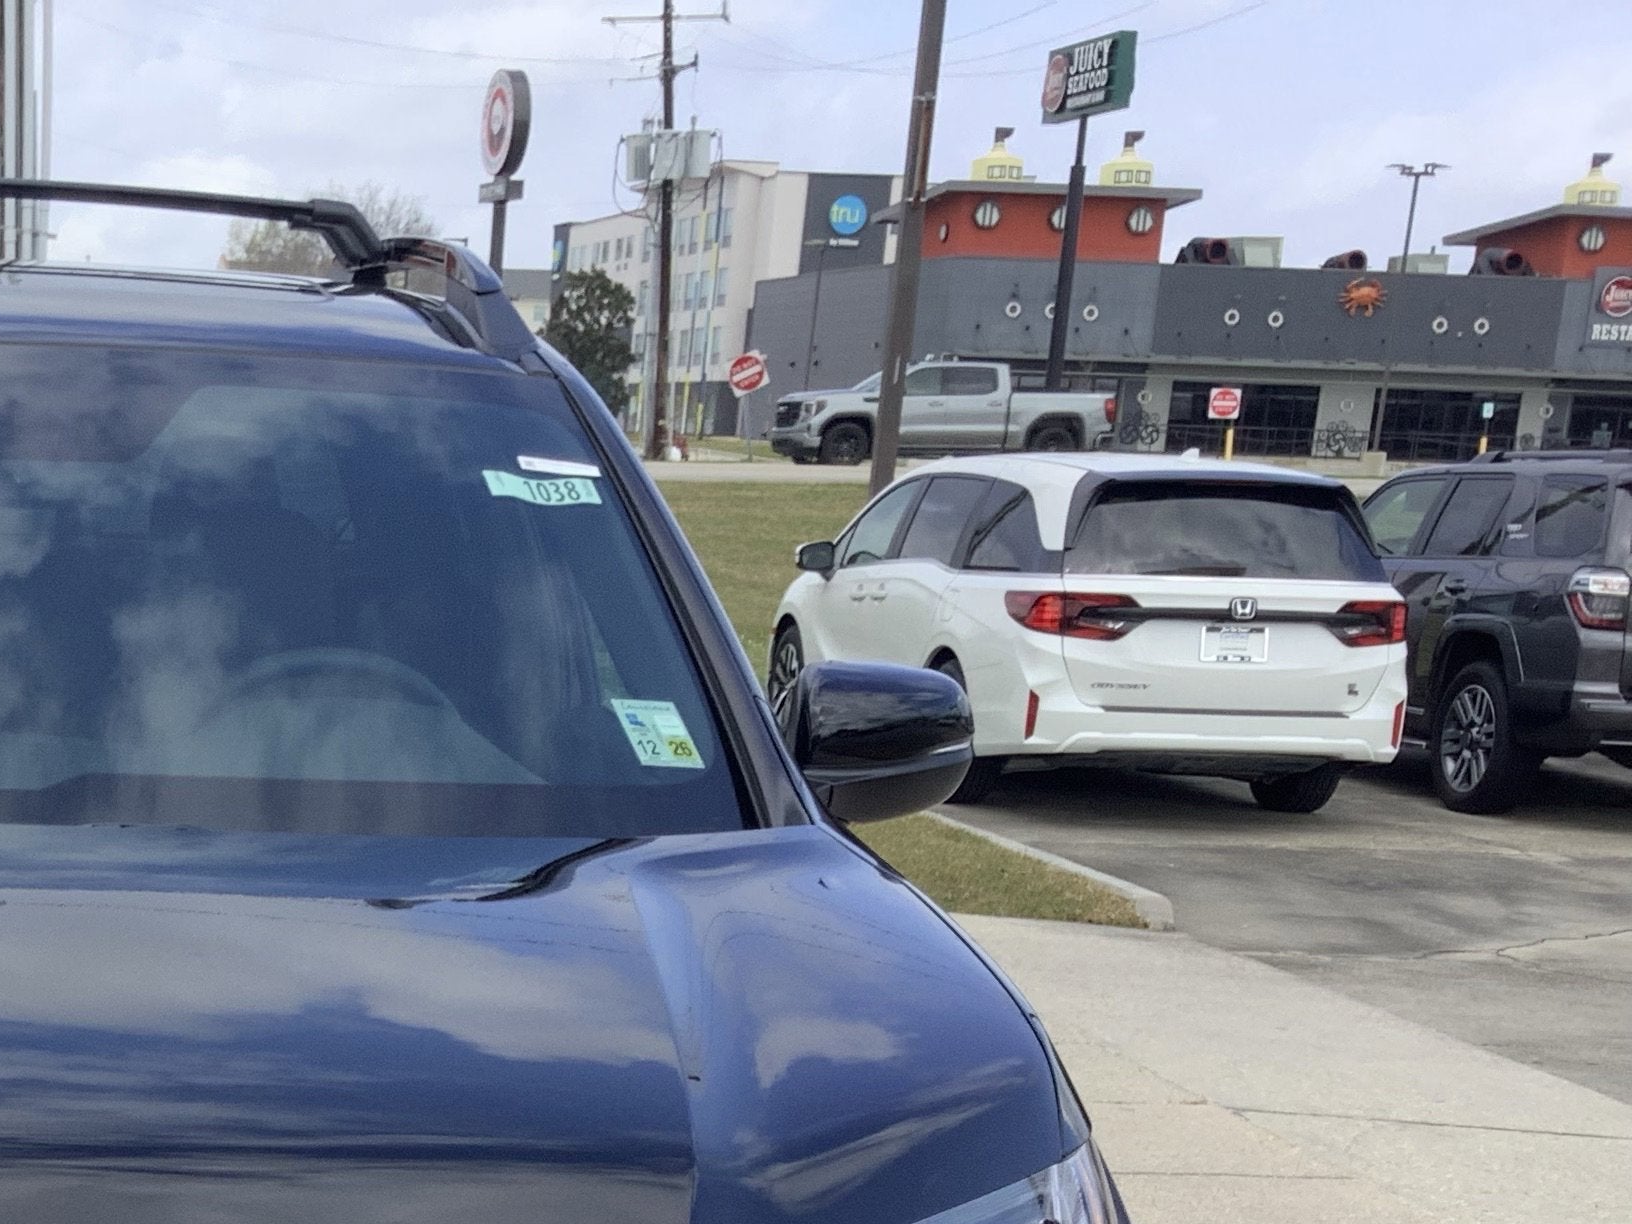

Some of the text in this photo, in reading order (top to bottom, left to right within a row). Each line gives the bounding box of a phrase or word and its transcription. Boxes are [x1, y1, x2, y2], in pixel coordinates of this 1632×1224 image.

[1069, 38, 1113, 75] JUICY
[1067, 67, 1108, 95] SEAFOOD
[830, 203, 860, 224] tru
[523, 480, 581, 502] 1038
[637, 739, 693, 757] 12 26
